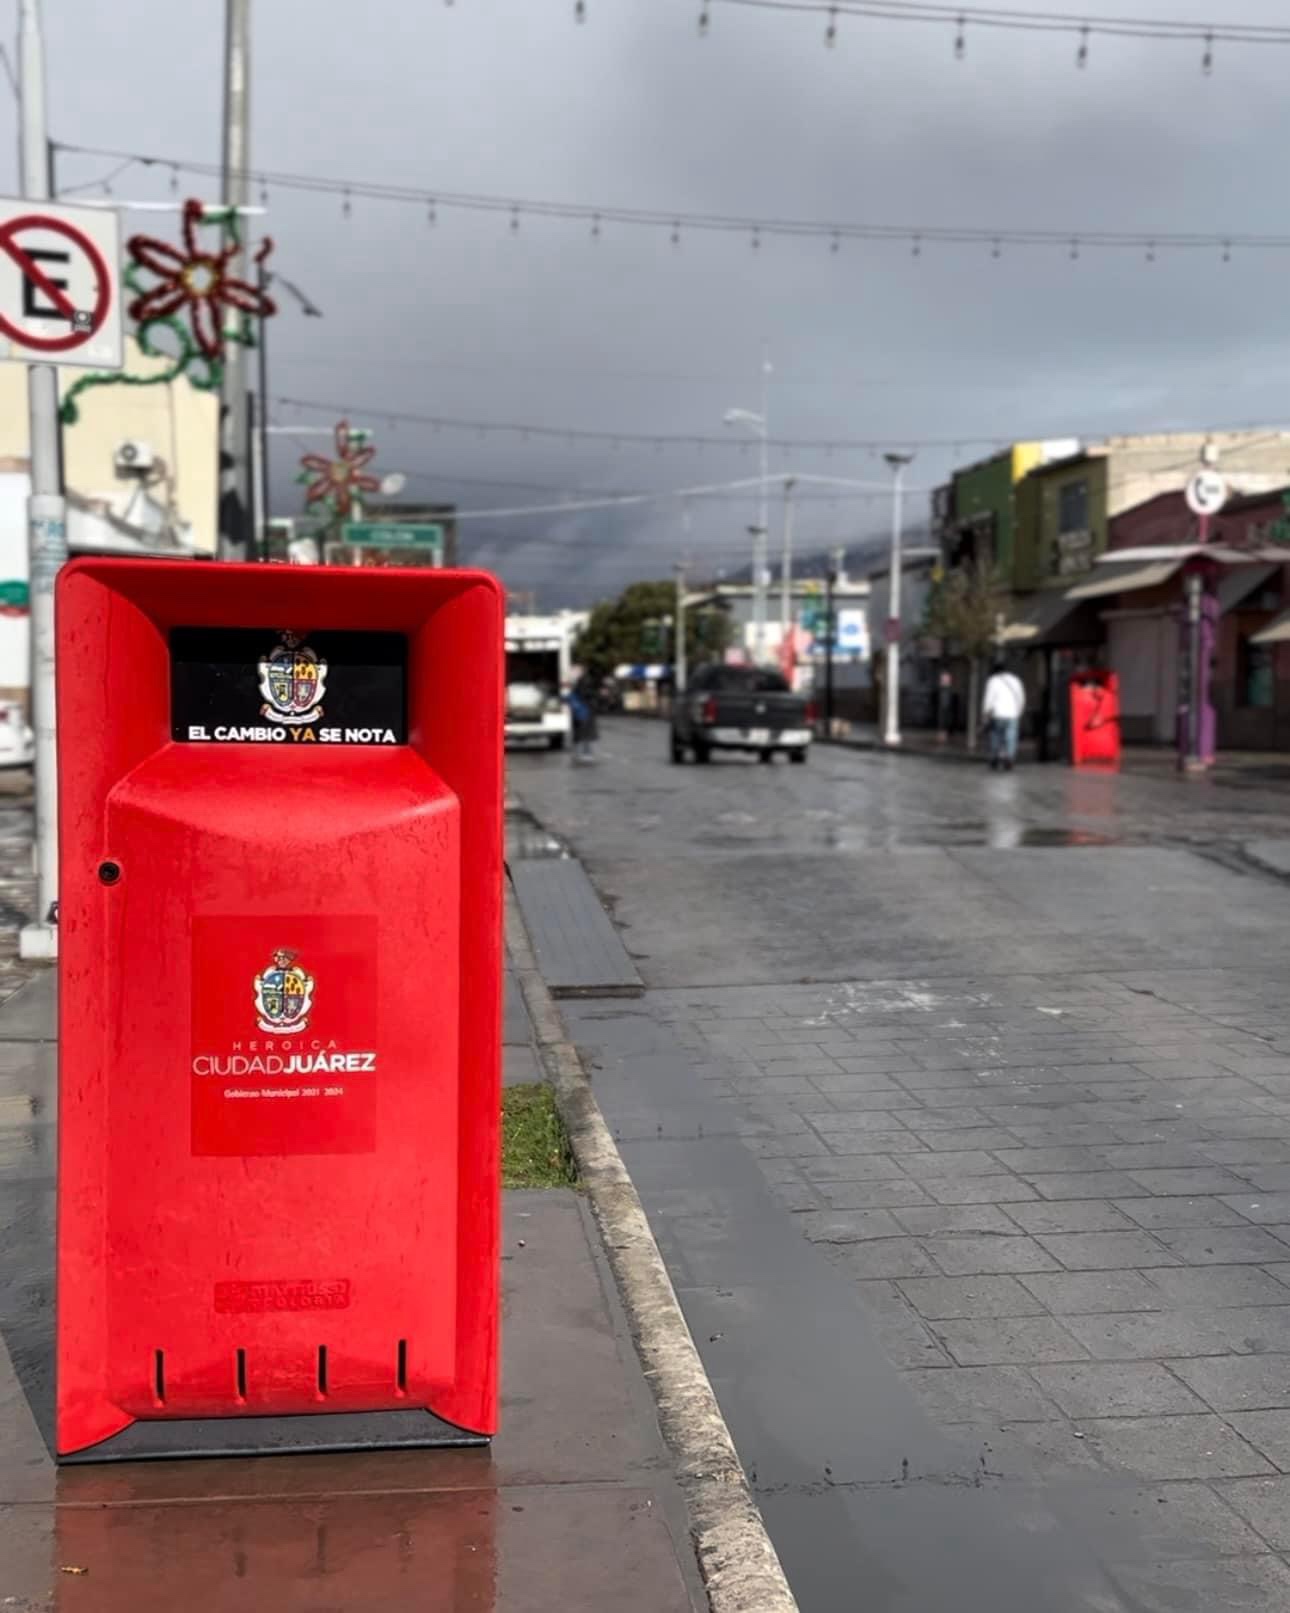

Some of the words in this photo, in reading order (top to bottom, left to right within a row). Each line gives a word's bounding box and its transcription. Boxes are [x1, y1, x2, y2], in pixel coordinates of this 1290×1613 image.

[23, 248, 71, 319] E
[188, 726, 211, 740] EL
[214, 726, 287, 741] CAMBIO
[289, 727, 316, 742] YA
[319, 728, 342, 742] SE
[345, 728, 397, 743] NOTA
[232, 1039, 337, 1051] HEROICA
[224, 1088, 260, 1098] Gobierno
[261, 1088, 300, 1099] Municipal
